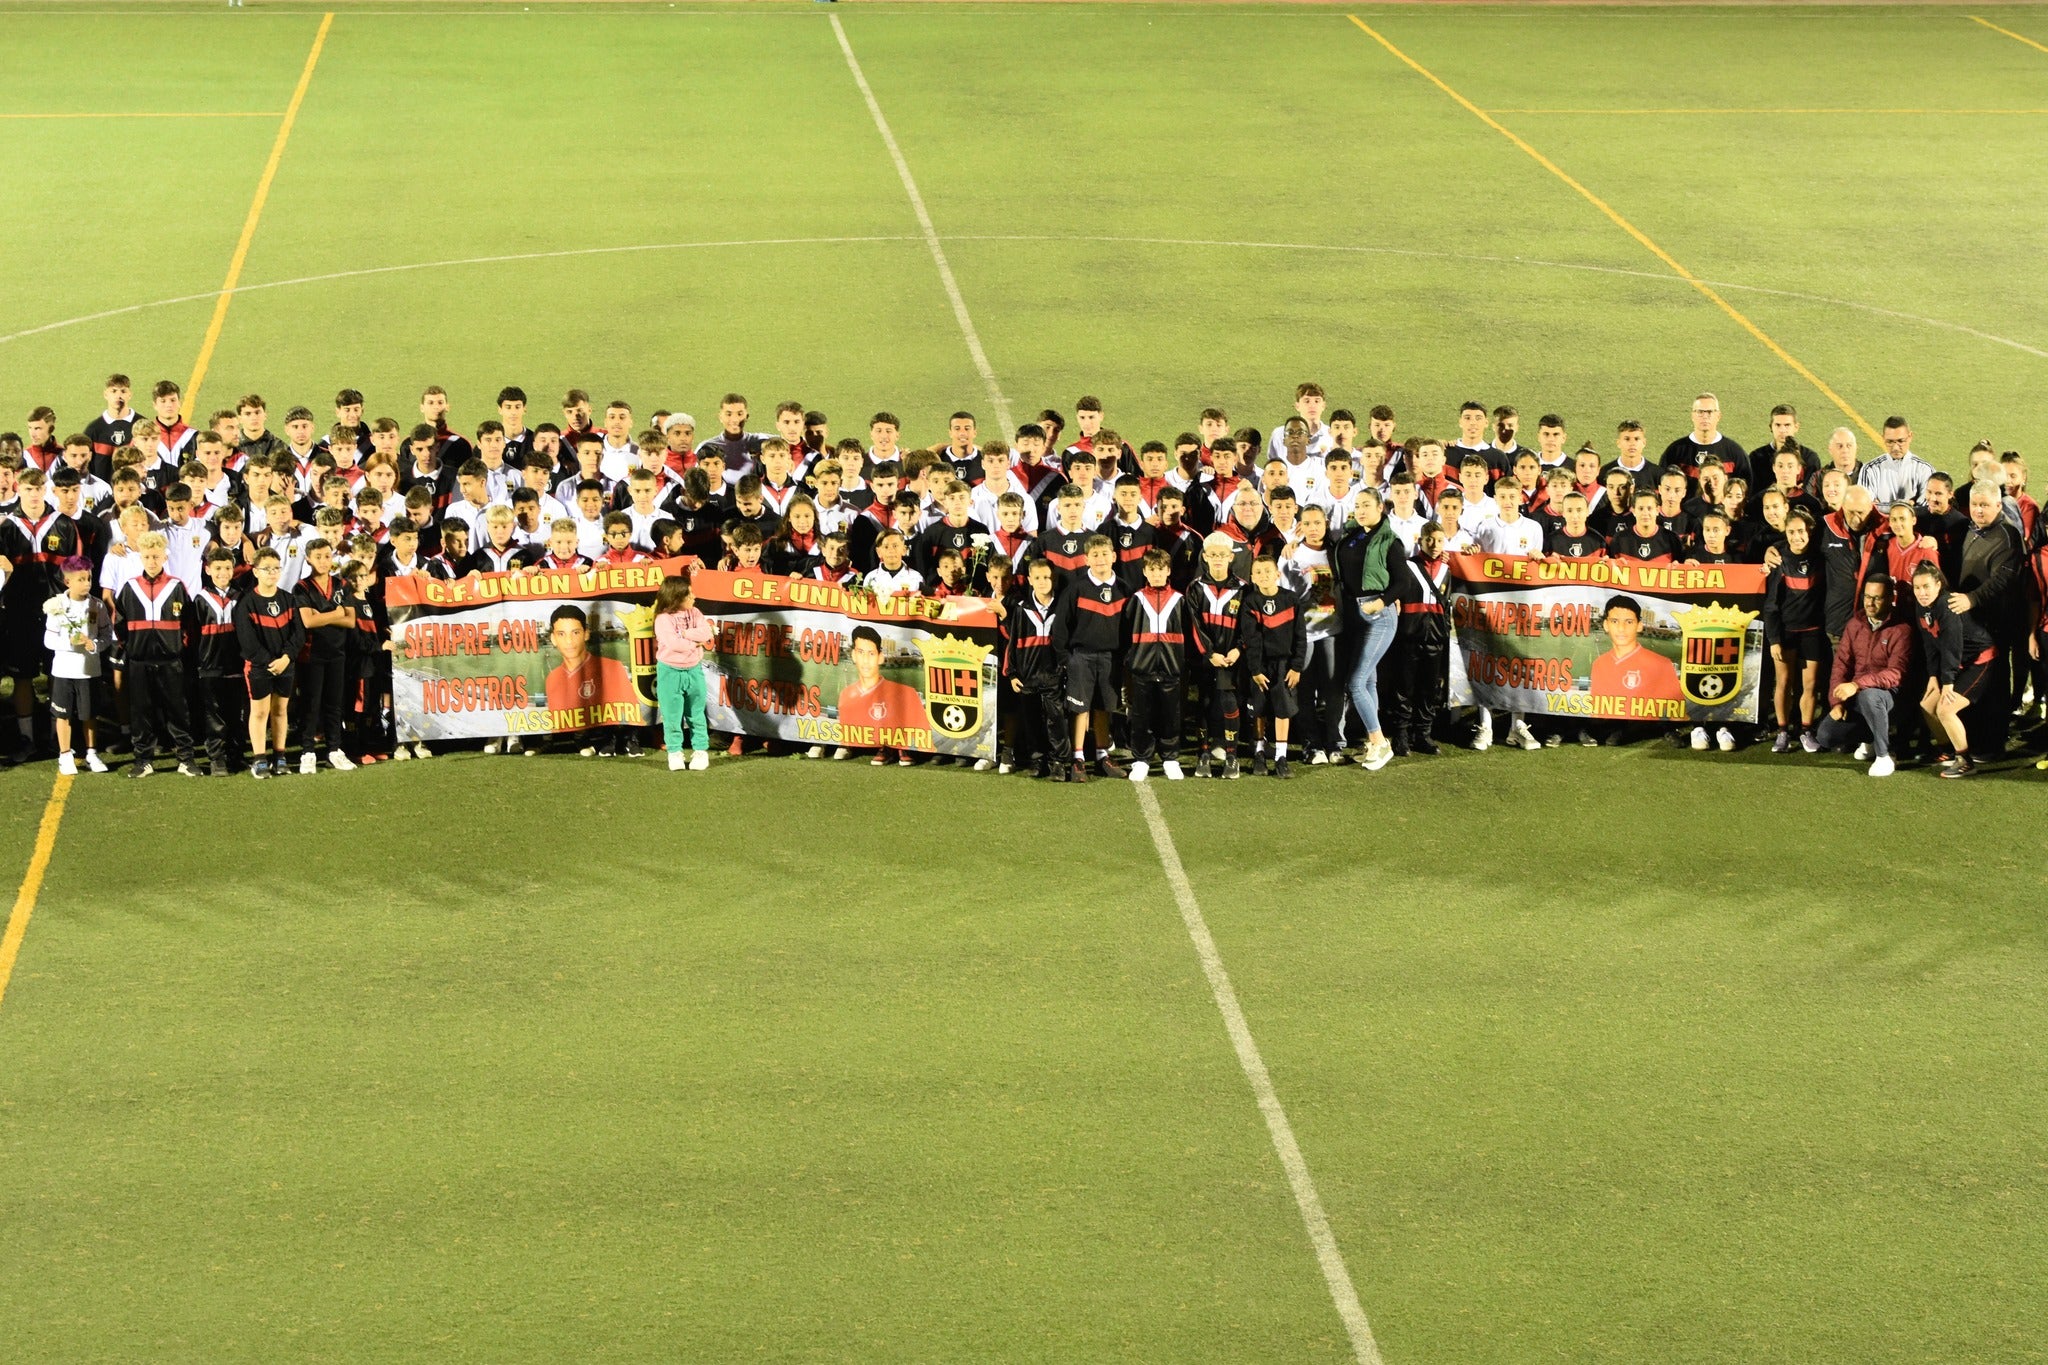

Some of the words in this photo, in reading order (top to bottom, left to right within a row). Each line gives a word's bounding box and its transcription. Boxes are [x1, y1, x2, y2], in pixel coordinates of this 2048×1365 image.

[426, 583, 473, 603] C.F.
[578, 566, 666, 593] VIERA
[1483, 558, 1532, 582] C.F.
[1637, 567, 1726, 589] VIERA
[732, 578, 781, 601] C.F.
[875, 596, 958, 621] VIERA
[1454, 595, 1543, 637] SIEMPRE
[1549, 603, 1592, 637] CON
[404, 622, 491, 659] SIEMPRE
[498, 619, 539, 654] CON
[800, 627, 841, 666] CON
[1468, 650, 1573, 692] NOSOTROS
[422, 675, 529, 714] NOSOTROS
[719, 674, 821, 718] NOSOTROS
[1546, 693, 1626, 717] YASSINE
[1631, 697, 1686, 718] HATRI
[504, 707, 586, 733] YASSINE
[589, 702, 641, 724] HATRI
[796, 718, 875, 745] YASSINE
[879, 727, 932, 749] HATRI
